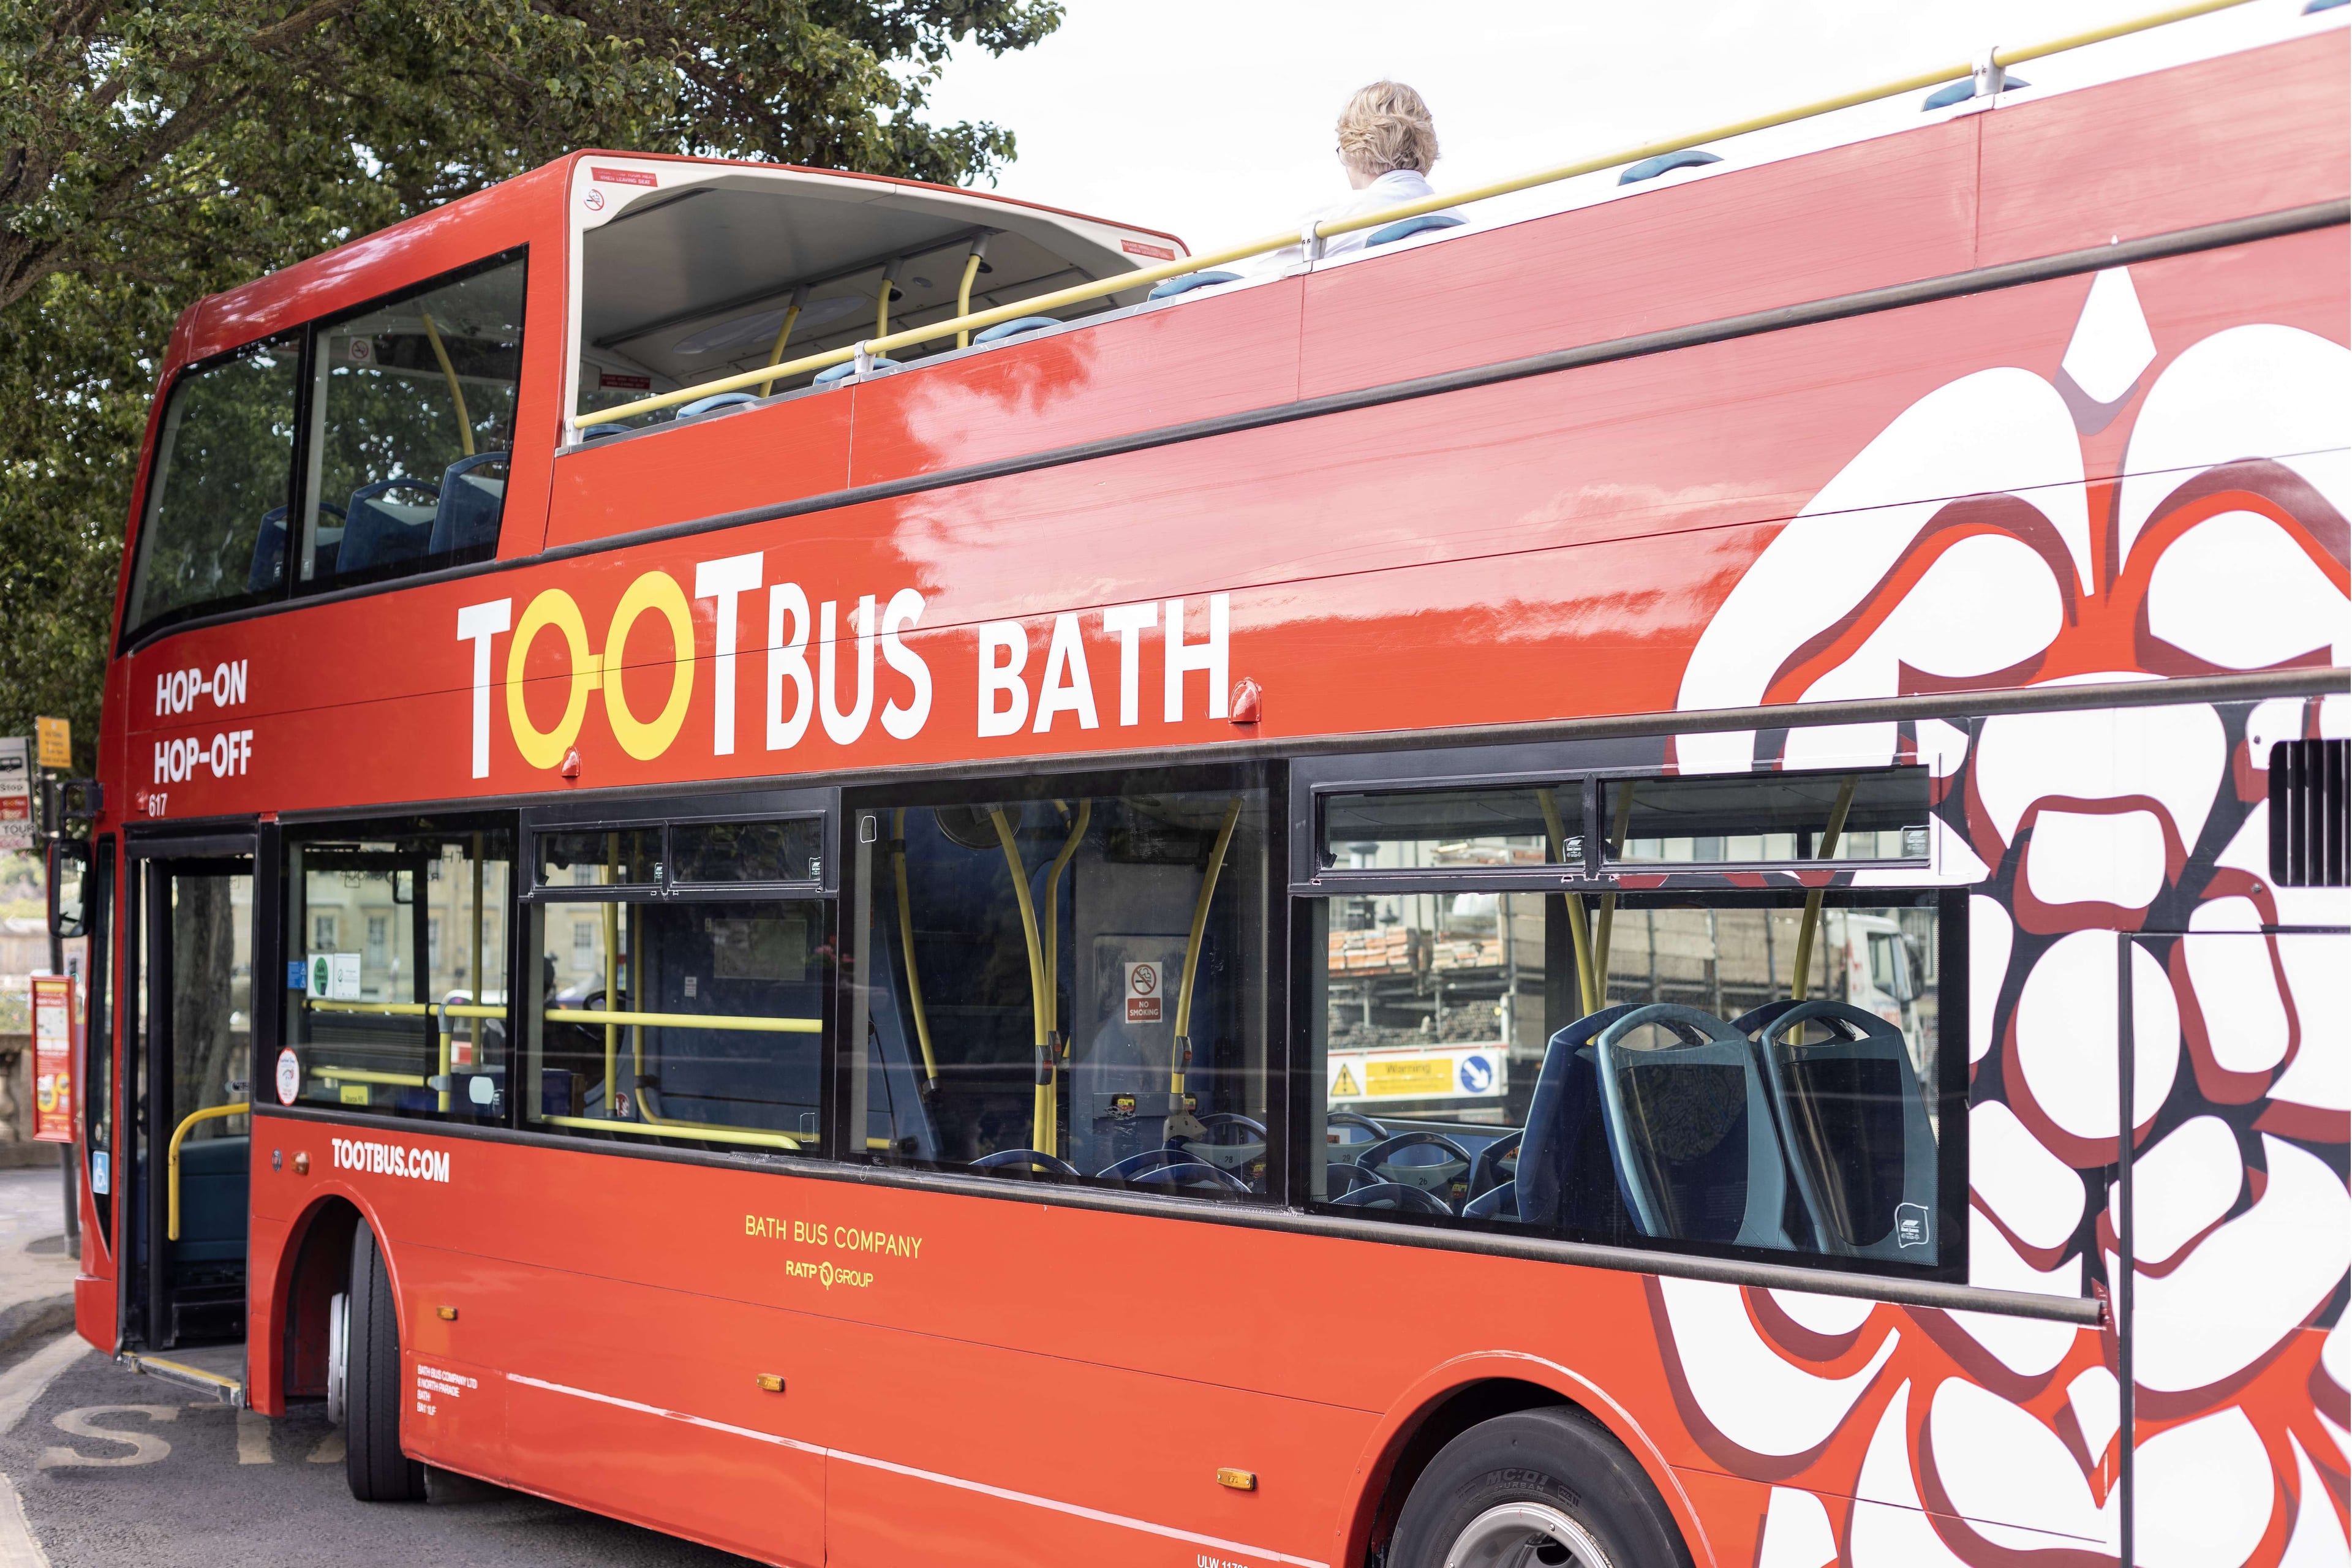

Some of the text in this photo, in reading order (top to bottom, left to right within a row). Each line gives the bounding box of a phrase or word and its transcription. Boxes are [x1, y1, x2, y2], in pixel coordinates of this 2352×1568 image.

[457, 551, 1230, 779] TOOTBUS BATH
[156, 659, 248, 716] HOP-ON
[154, 729, 254, 784] HOP-OFF
[148, 793, 168, 818] 617
[331, 1137, 450, 1183] TOOTBUS.COM
[1419, 1177, 1428, 1186] 26
[745, 1215, 922, 1259] BATH BUS COMPANY
[786, 1260, 873, 1287] RATP GROUP
[417, 1363, 478, 1389] BATH BUS COMPANY LTD
[421, 1378, 439, 1392] NORTH
[439, 1382, 461, 1398] PARADE
[417, 1389, 431, 1402] BATH
